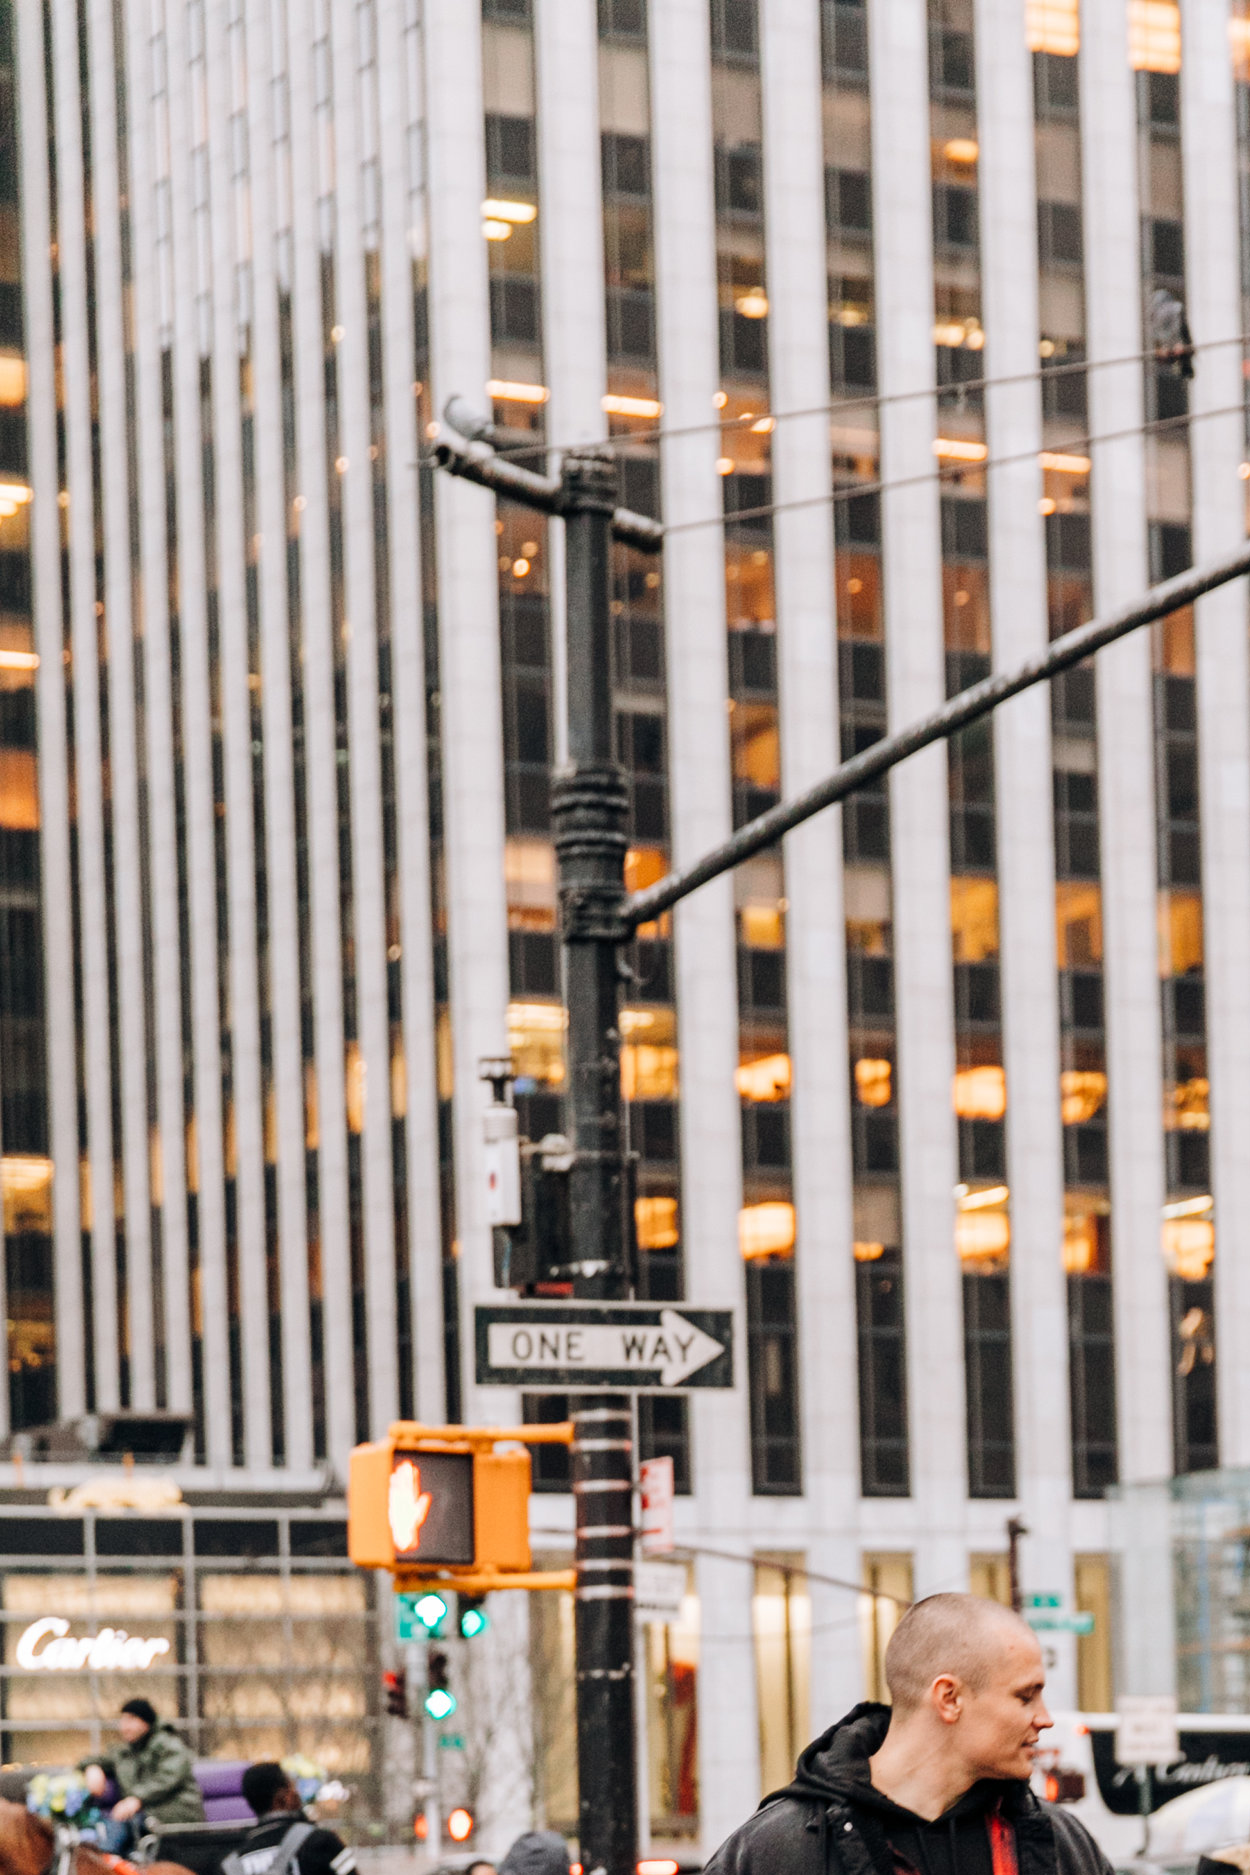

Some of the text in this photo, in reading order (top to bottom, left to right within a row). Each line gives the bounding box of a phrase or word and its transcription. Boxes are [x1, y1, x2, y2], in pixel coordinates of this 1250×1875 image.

[511, 1330, 695, 1363] ONE WAY
[16, 1616, 170, 1670] Cartier
